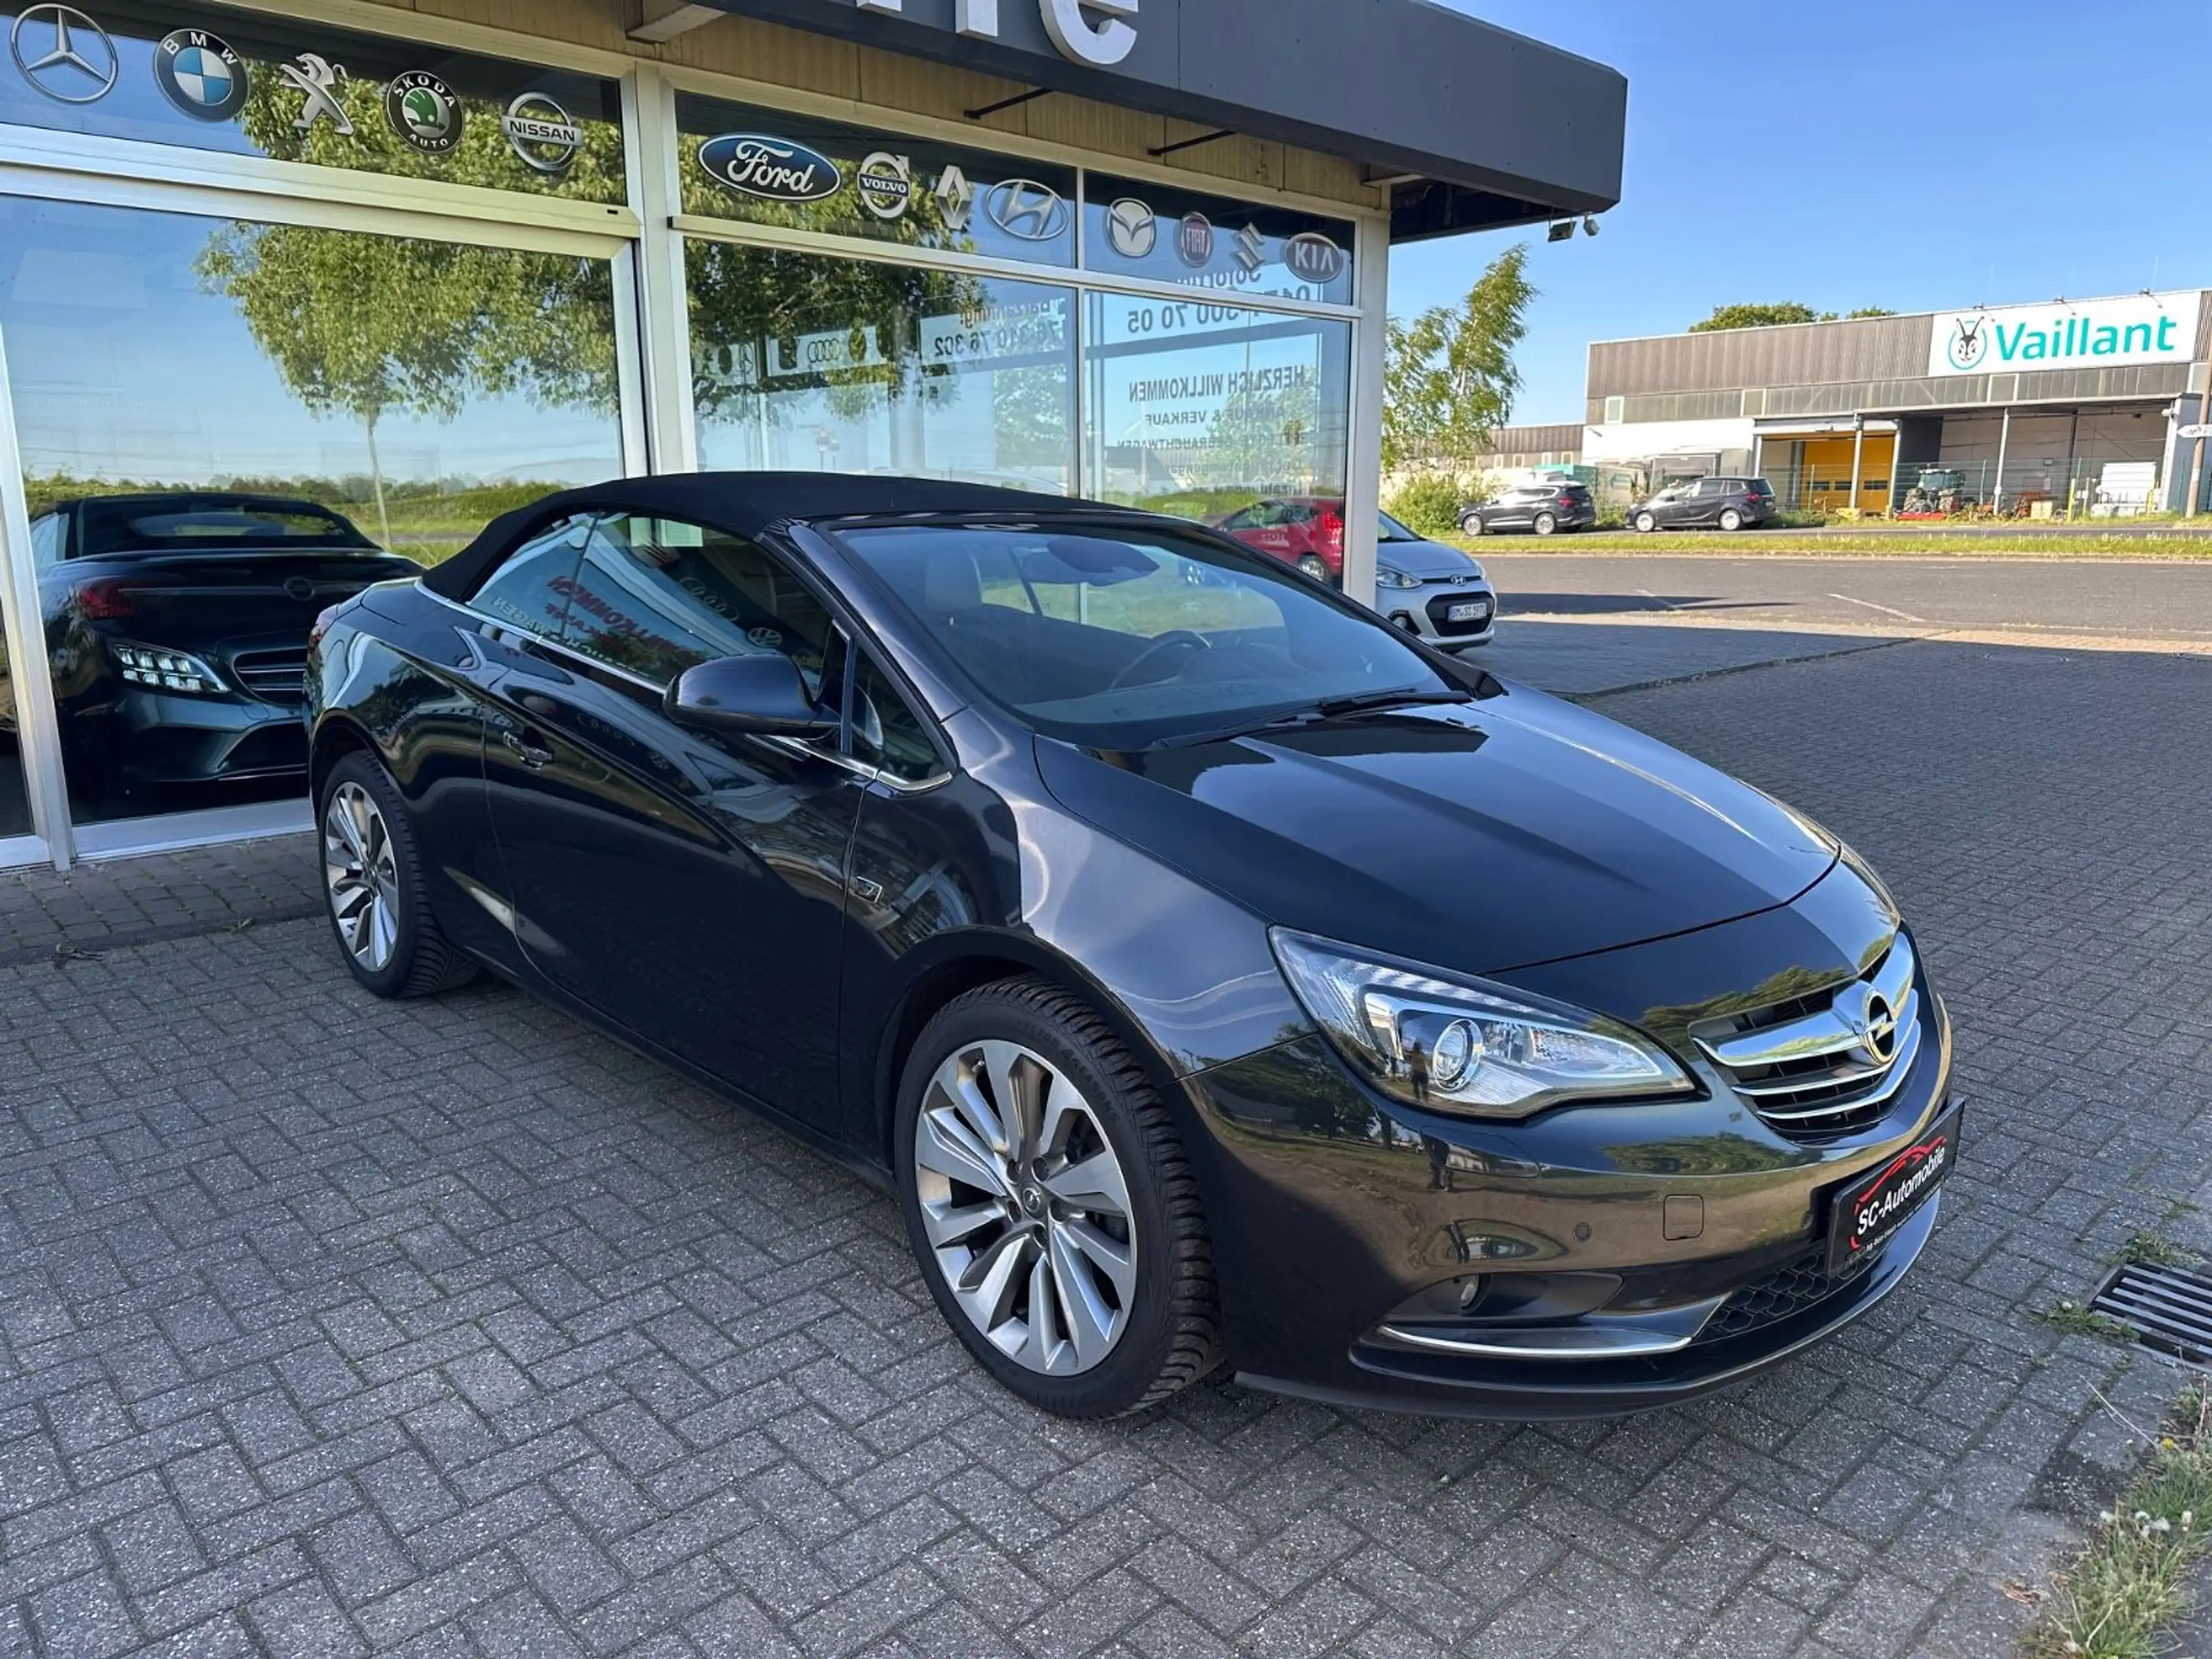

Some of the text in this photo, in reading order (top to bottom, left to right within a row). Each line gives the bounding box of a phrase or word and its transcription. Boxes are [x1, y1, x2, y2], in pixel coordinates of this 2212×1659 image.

[163, 32, 238, 65] BMW
[409, 134, 448, 148] AUTO
[509, 120, 575, 142] NISSAN
[727, 141, 816, 193] Ford
[861, 176, 907, 194] VOLVO
[1185, 228, 1206, 254] FIAT
[1295, 241, 1334, 273] KIA
[1995, 315, 2177, 361] Vaillant
[1857, 1145, 1945, 1236] SC-Automobile
